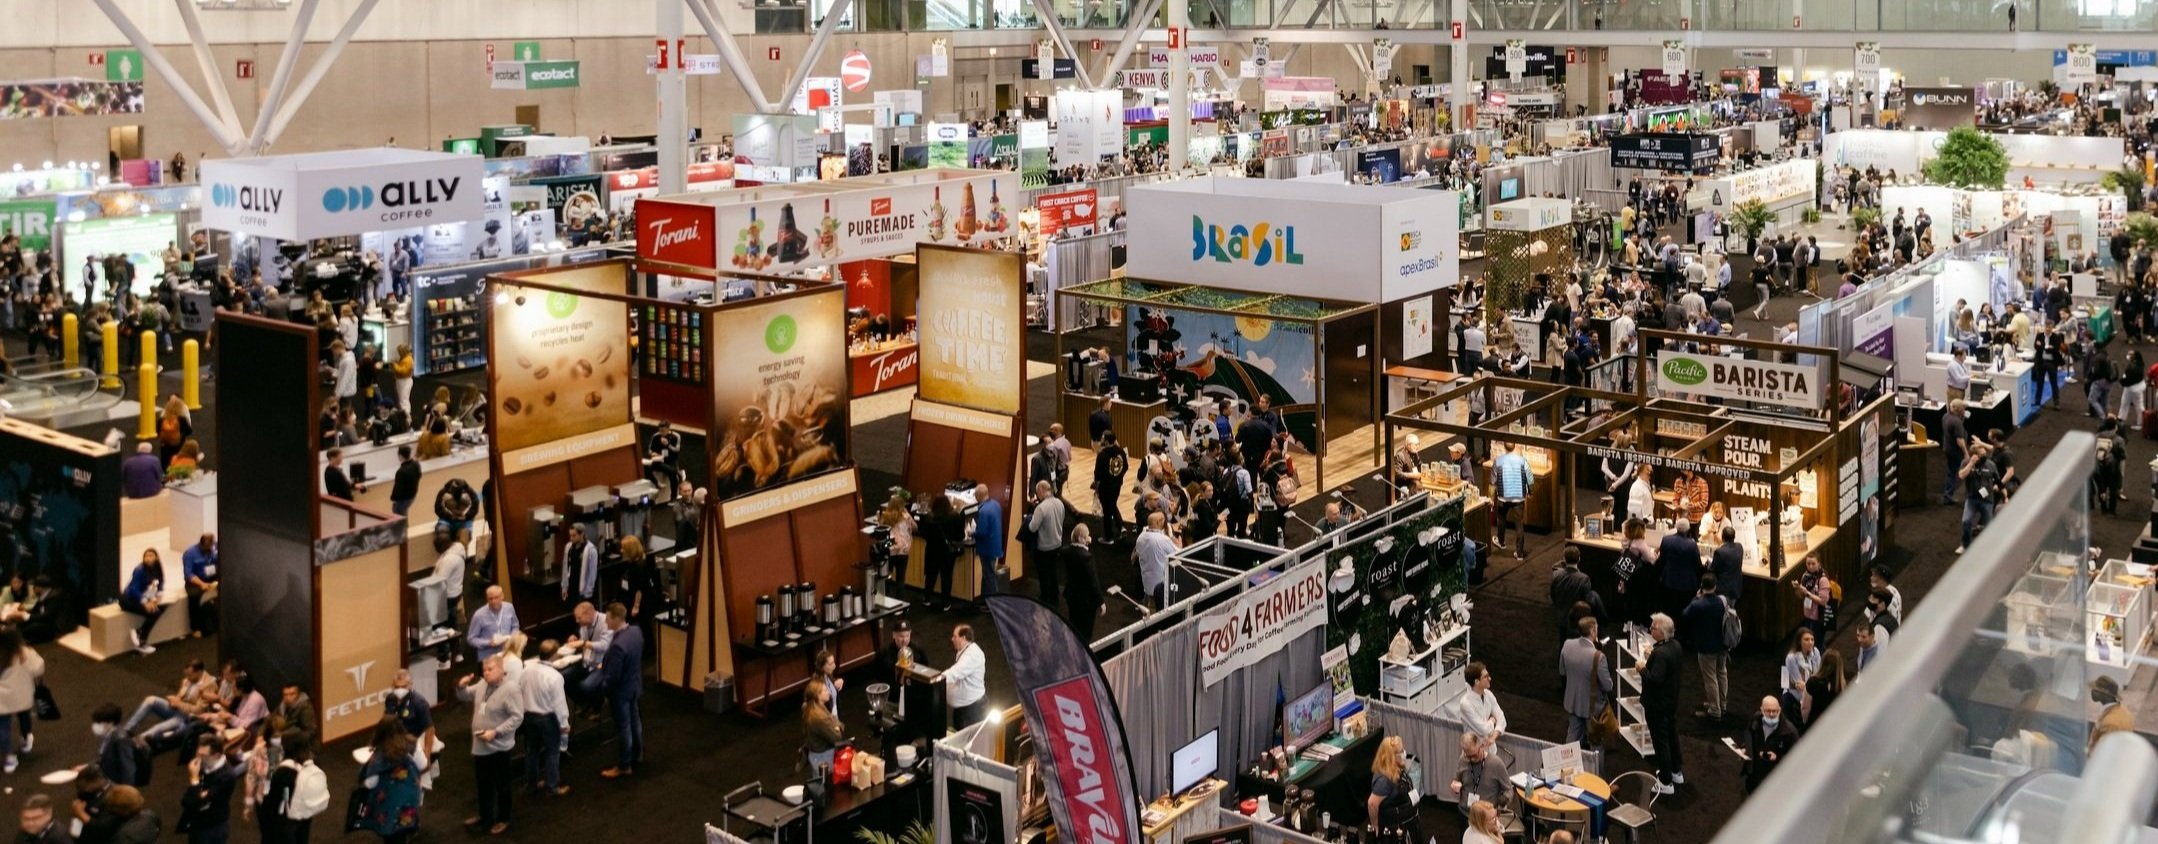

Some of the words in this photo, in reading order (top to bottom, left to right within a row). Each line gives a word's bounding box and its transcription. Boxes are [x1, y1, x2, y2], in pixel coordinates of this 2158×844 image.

[1190, 53, 1217, 62] HARIO
[1376, 49, 1388, 58] 400
[1668, 52, 1681, 61] 600
[1861, 54, 1876, 64] 700
[2073, 56, 2091, 68] 800
[496, 70, 520, 80] ecotact
[531, 68, 576, 81] ecotact
[1128, 71, 1156, 87] KENYA
[1926, 95, 1968, 104] BUNN
[547, 183, 598, 200] ARISTA
[848, 214, 916, 237] PUREMADE
[650, 218, 700, 256] Torani
[860, 236, 879, 246] SYRUPS
[886, 233, 904, 242] SAUCES
[1400, 255, 1438, 276] apexBrasil
[570, 320, 593, 330] design
[570, 334, 584, 342] heat
[934, 336, 1006, 374] TIME
[758, 359, 781, 374] energy
[783, 355, 805, 368] saving
[870, 352, 917, 392] Toran
[1666, 360, 1703, 378] Pacific
[763, 370, 800, 386] technology
[1713, 363, 1808, 394] BARISTA
[1494, 390, 1524, 406] NEW
[1737, 388, 1784, 400] SERIES
[916, 405, 945, 418] FROZEN
[946, 410, 968, 422] DRINK
[968, 414, 1007, 430] MACHINES
[1588, 447, 1621, 460] BARISTA
[1624, 452, 1662, 466] INSPIRED
[1666, 460, 1701, 472] BARISTA
[1704, 465, 1750, 479] APPROVED
[732, 496, 781, 518] GRINDERS
[792, 477, 849, 502] DISPENSERS
[1437, 530, 1460, 550] roast
[1371, 561, 1398, 584] roast
[1616, 556, 1636, 574] 183
[1200, 616, 1239, 660] FOOD
[1242, 606, 1253, 639] 4
[1254, 571, 1324, 632] FARMERS
[1202, 662, 1216, 672] ood
[1216, 655, 1230, 668] Food
[1229, 645, 1246, 658] Every
[1246, 640, 1257, 650] Day
[1264, 627, 1284, 640] Coffee
